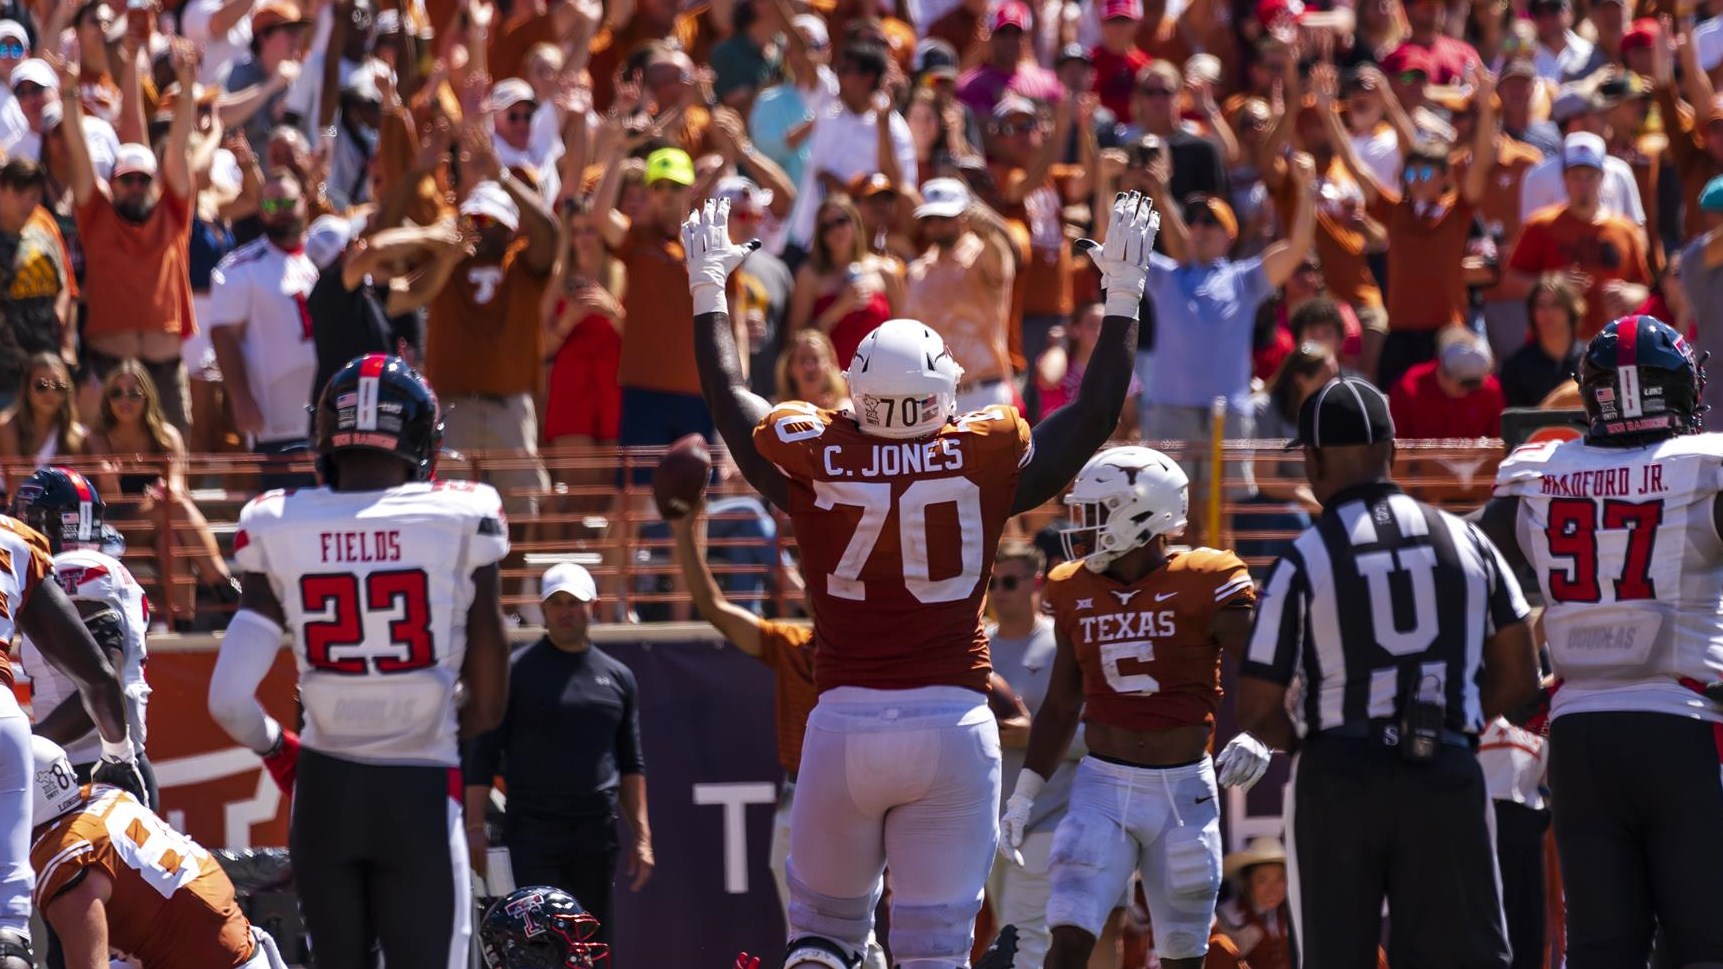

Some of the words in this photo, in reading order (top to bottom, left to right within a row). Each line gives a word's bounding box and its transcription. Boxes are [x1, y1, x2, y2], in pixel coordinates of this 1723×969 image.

[880, 397, 918, 427] 70
[824, 445, 853, 476] C.
[862, 438, 964, 477] JONES
[1638, 464, 1669, 495] JR.
[320, 531, 401, 563] FIELDS
[812, 477, 984, 603] 70
[1544, 497, 1665, 604] 97
[299, 568, 438, 676] 23
[1079, 611, 1176, 643] TEXAS
[1356, 546, 1440, 656] U
[1100, 640, 1160, 696] 5
[693, 781, 775, 893] T
